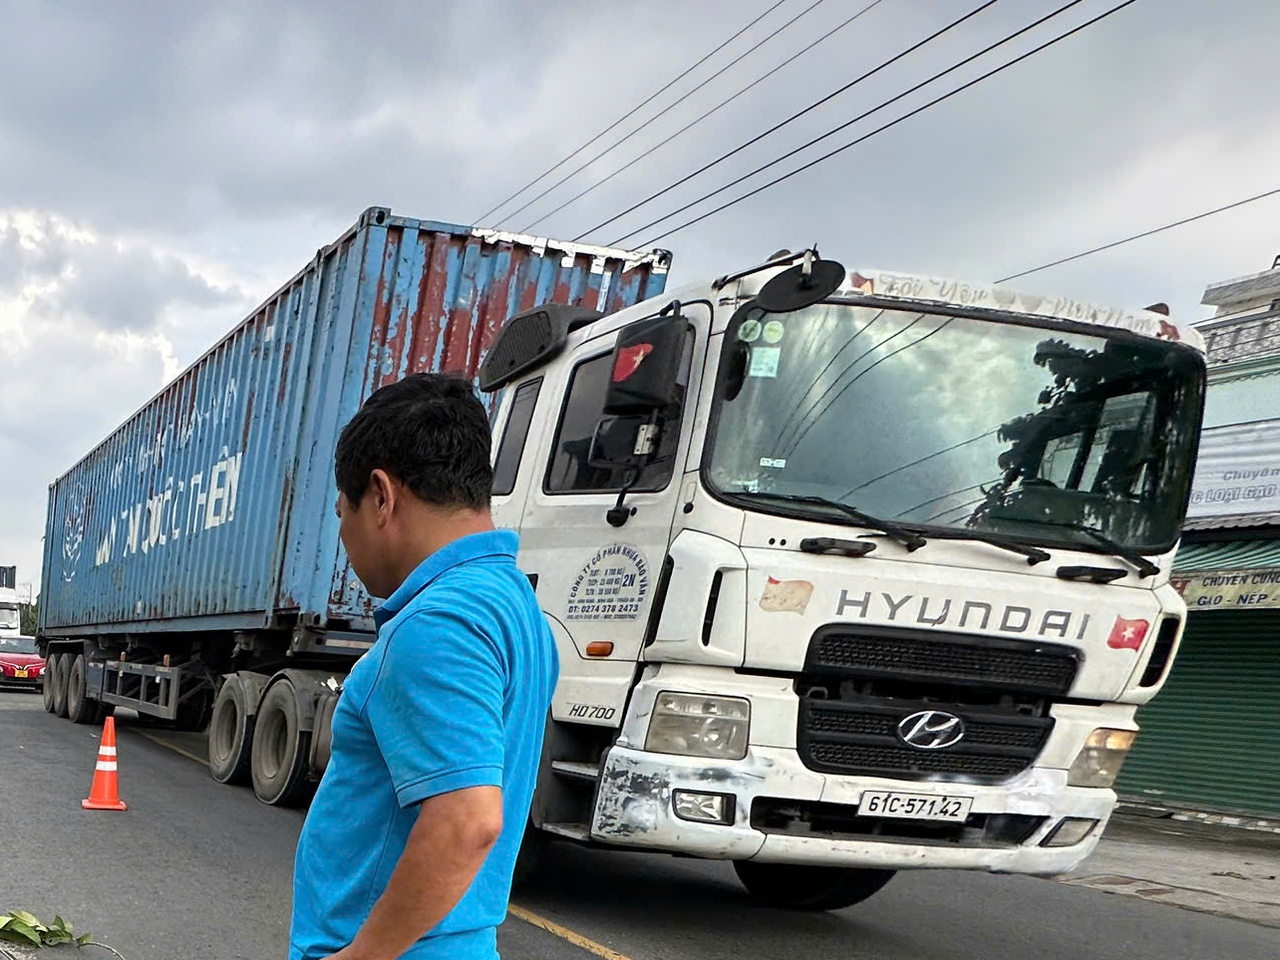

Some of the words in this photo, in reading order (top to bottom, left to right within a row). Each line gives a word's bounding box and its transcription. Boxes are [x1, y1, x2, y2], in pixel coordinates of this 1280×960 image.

[582, 563, 591, 575] TY
[622, 573, 636, 587] 2N
[581, 604, 600, 613] 0274
[601, 604, 616, 613] 378
[617, 604, 638, 613] 2473
[836, 589, 1090, 640] HYUNDAI
[868, 796, 962, 817] 61C-571.42
